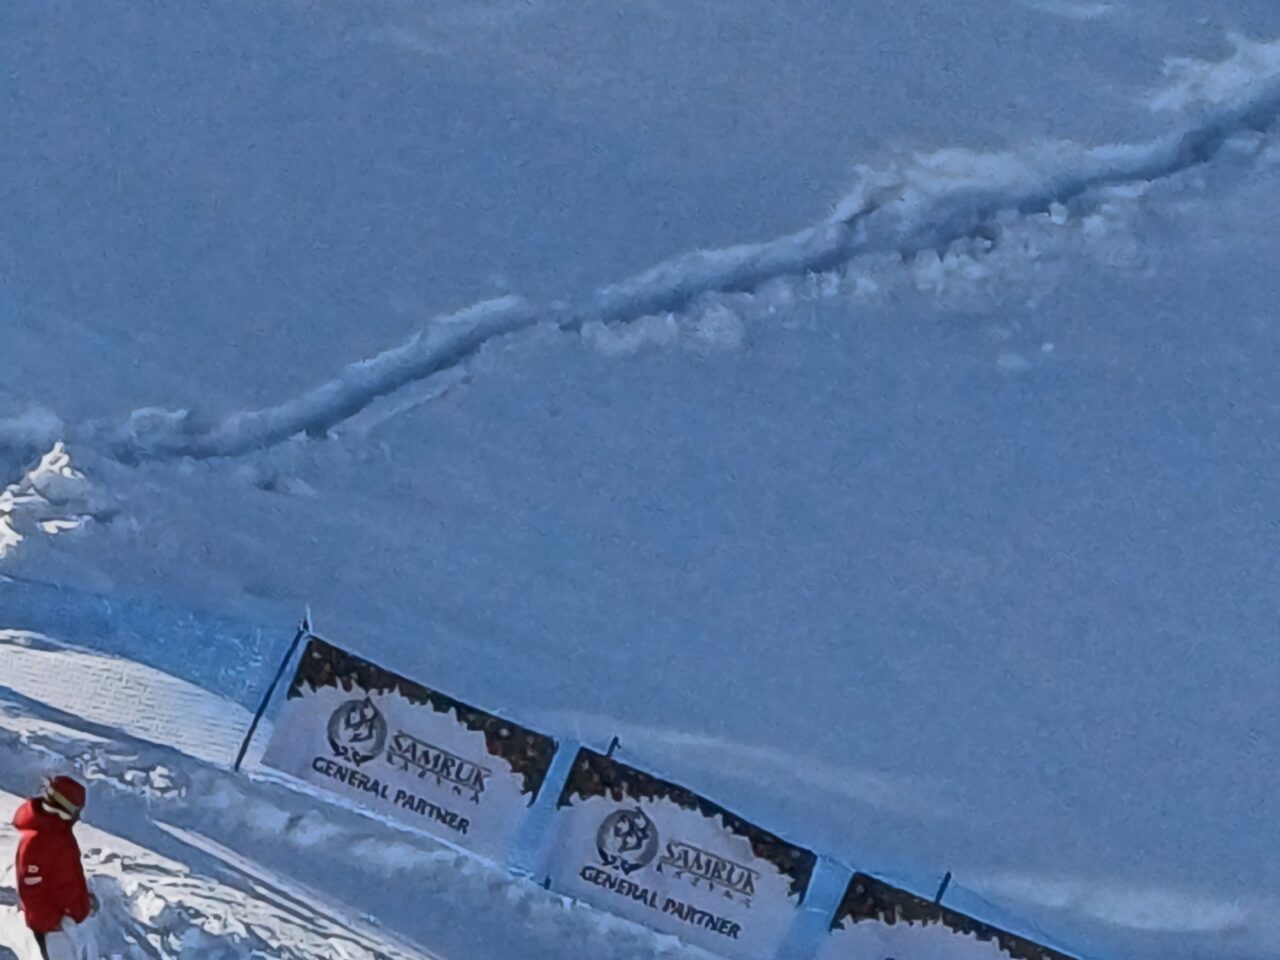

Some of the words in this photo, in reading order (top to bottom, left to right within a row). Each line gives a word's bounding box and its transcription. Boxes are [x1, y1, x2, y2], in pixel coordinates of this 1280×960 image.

[312, 756, 389, 800] GENERAL
[394, 789, 470, 834] PARTNER
[389, 730, 492, 793] SAMRUK
[579, 865, 658, 909] GENERAL
[662, 898, 742, 939] PARTNER
[661, 841, 760, 896] SAMRUK
